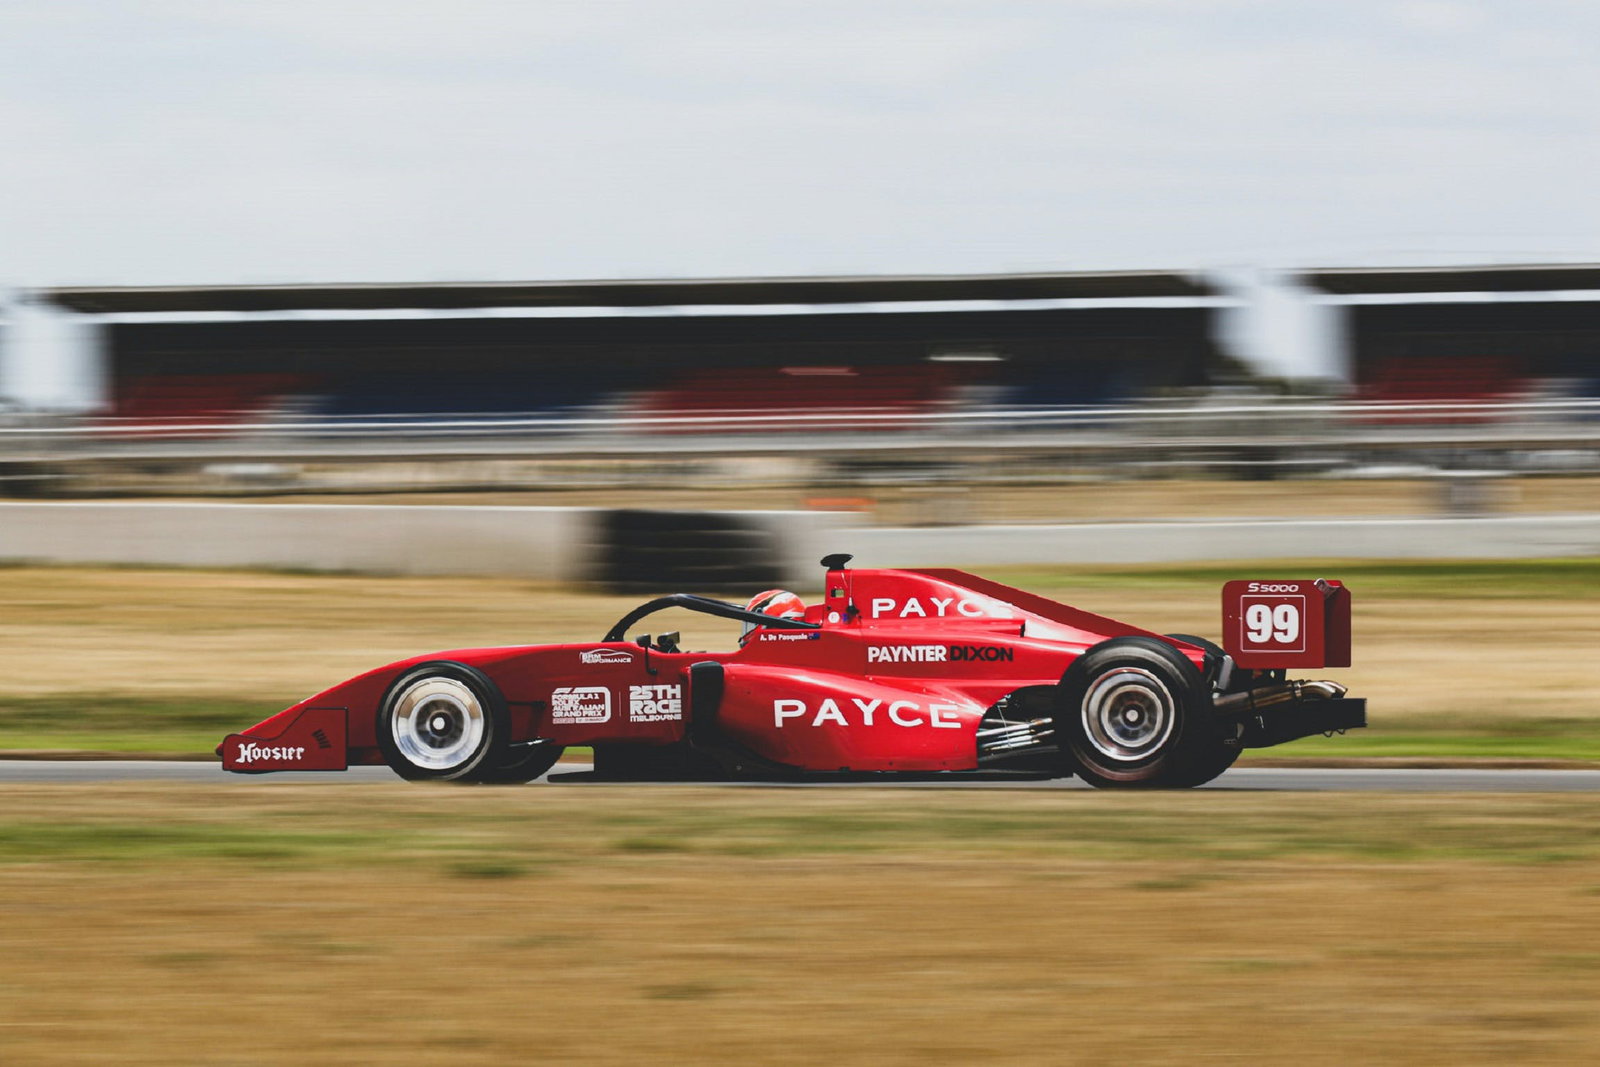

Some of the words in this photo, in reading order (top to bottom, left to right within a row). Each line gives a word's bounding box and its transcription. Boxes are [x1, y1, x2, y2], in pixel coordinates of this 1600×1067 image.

[1248, 583, 1299, 592] S5000
[1246, 604, 1299, 643] 99
[868, 645, 947, 662] PAYNTER
[950, 645, 1013, 662] DIXON
[629, 684, 681, 700] 25TH
[774, 698, 961, 728] PAYCE
[235, 742, 305, 763] Hoosier
